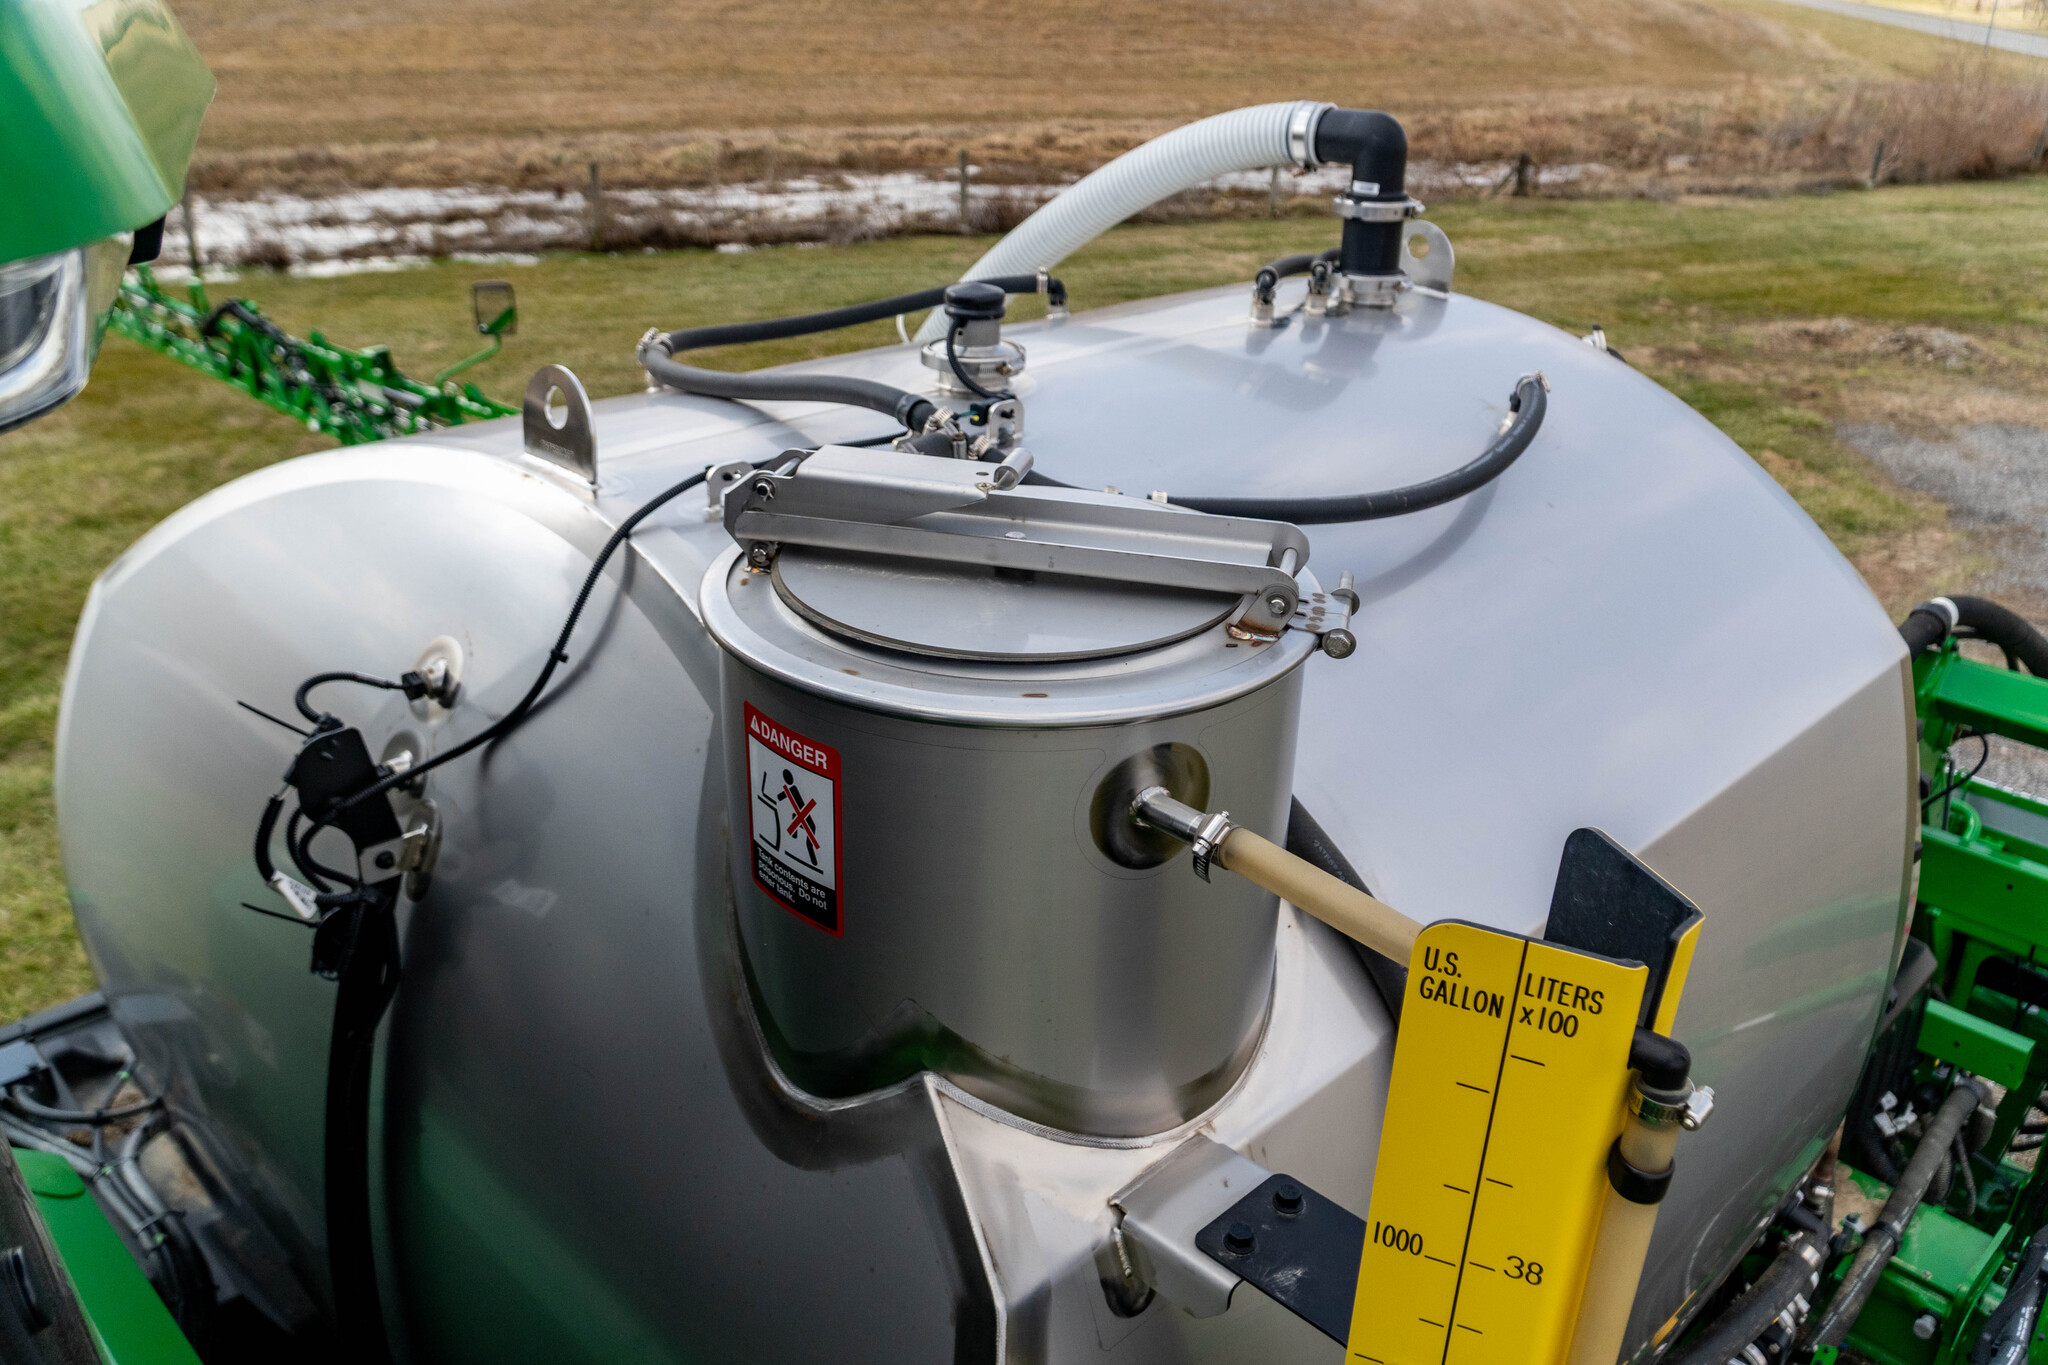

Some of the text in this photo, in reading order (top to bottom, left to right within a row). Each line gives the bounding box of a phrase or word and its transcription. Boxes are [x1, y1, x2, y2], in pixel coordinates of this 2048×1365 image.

[761, 720, 827, 770] DANGER
[757, 846, 826, 898] Tank contents are
[758, 860, 828, 910] poisonous. Do not
[758, 870, 796, 903] enter tank.
[1424, 946, 1462, 978] U.S.
[1419, 976, 1505, 1019] GALLON
[1524, 973, 1605, 1015] LITERS
[1373, 1221, 1423, 1256] 1000
[1503, 1255, 1544, 1286] 38
